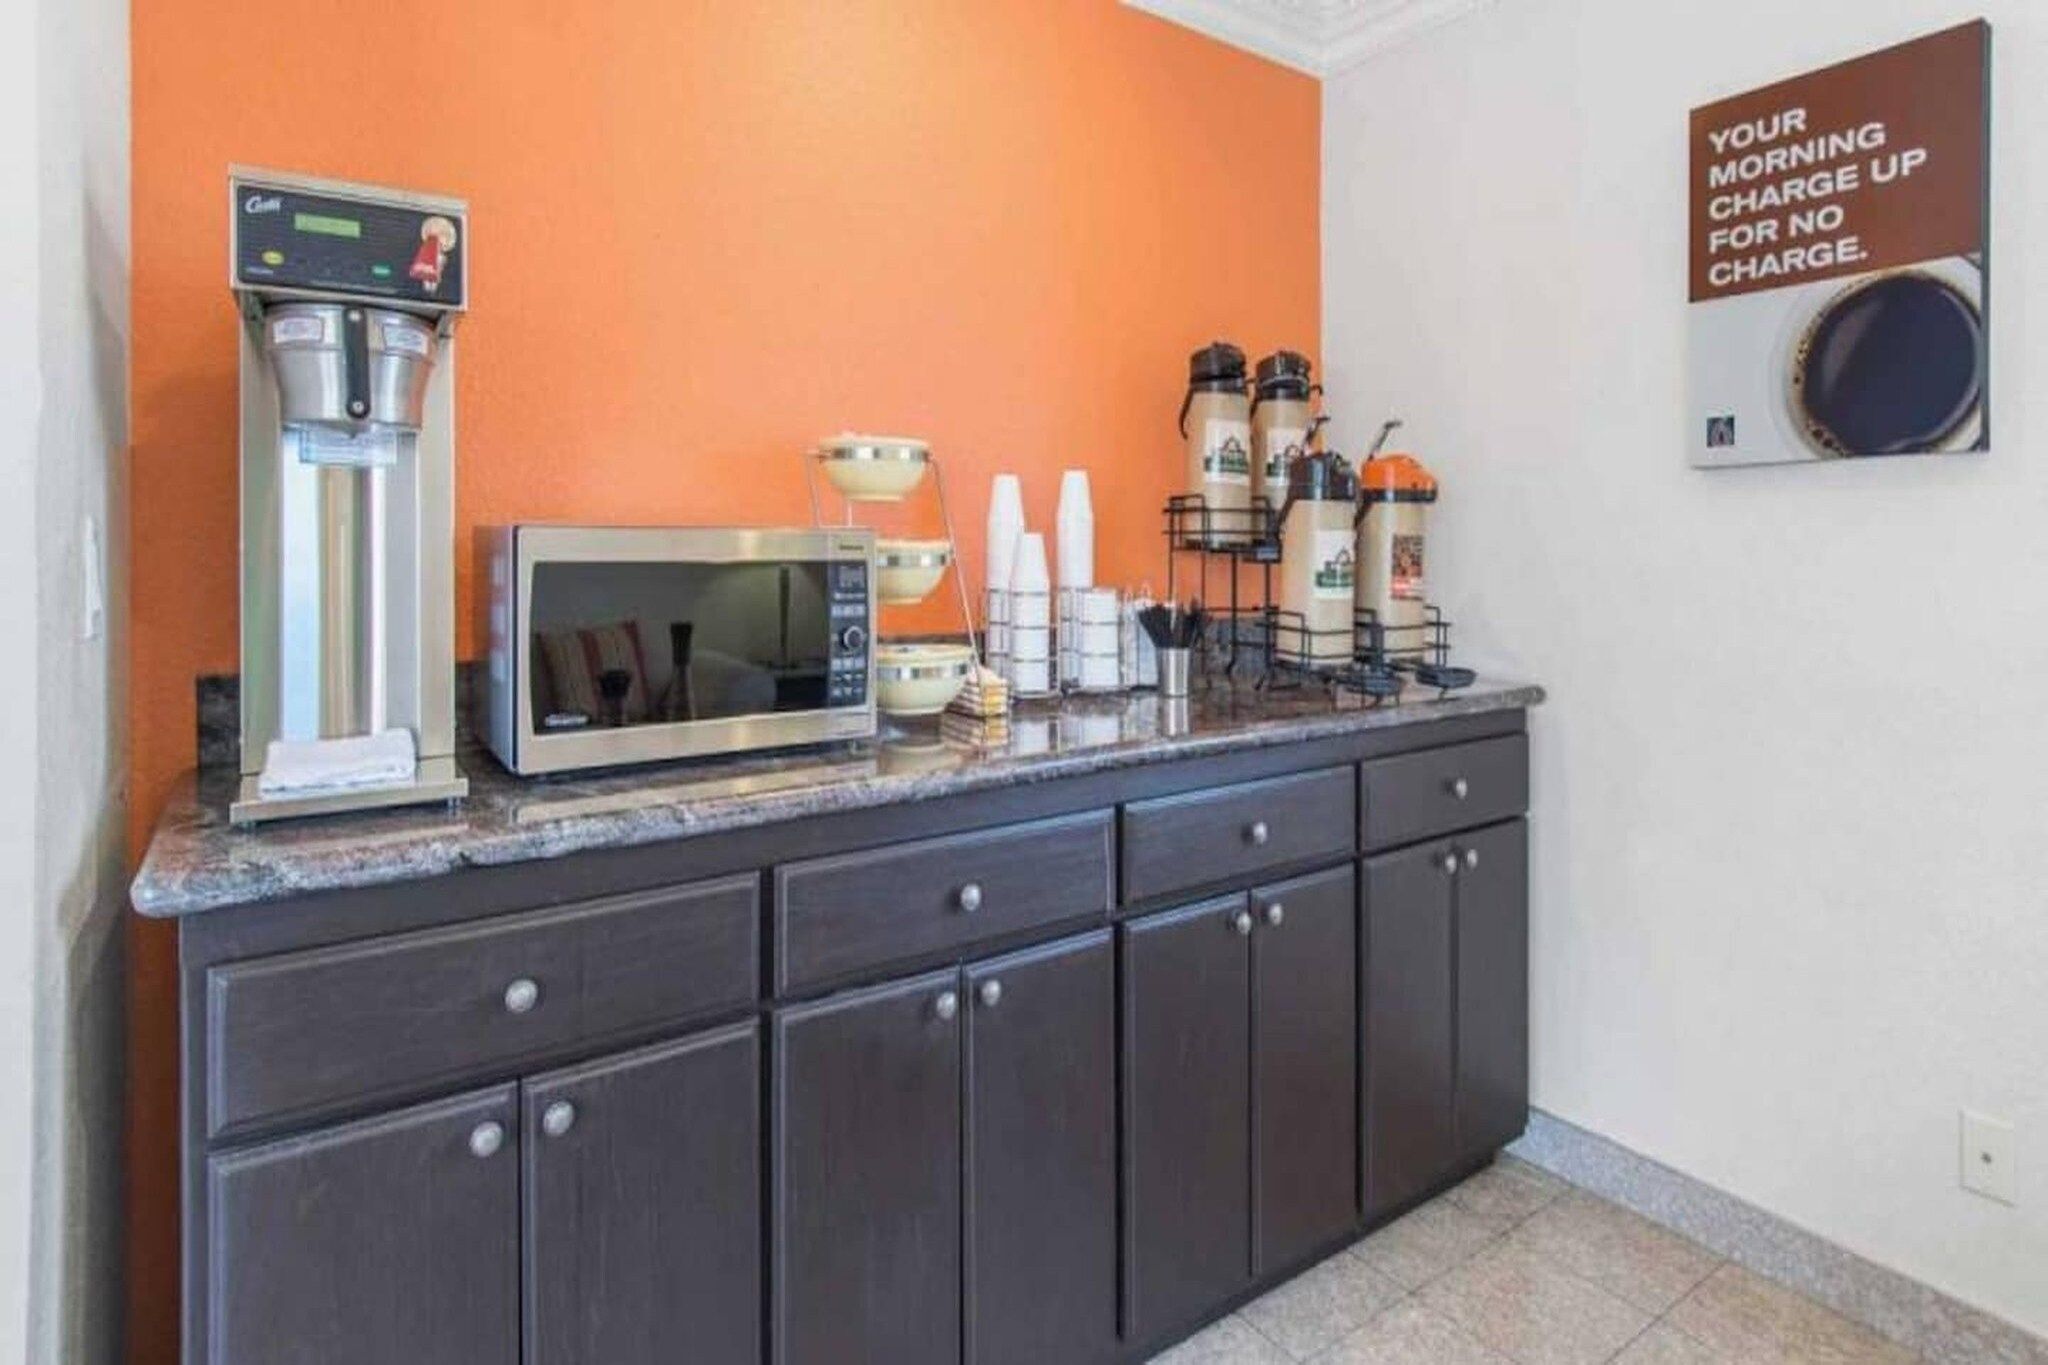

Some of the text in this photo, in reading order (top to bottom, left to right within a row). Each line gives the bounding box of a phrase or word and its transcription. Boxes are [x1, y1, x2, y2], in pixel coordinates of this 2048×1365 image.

[1709, 108, 1806, 152] YOUR
[1709, 122, 1886, 187] MORNING
[1709, 149, 1926, 220] CHARGE UP
[1709, 205, 1843, 253] FOR NO
[1709, 236, 1868, 286] CHARGE.
